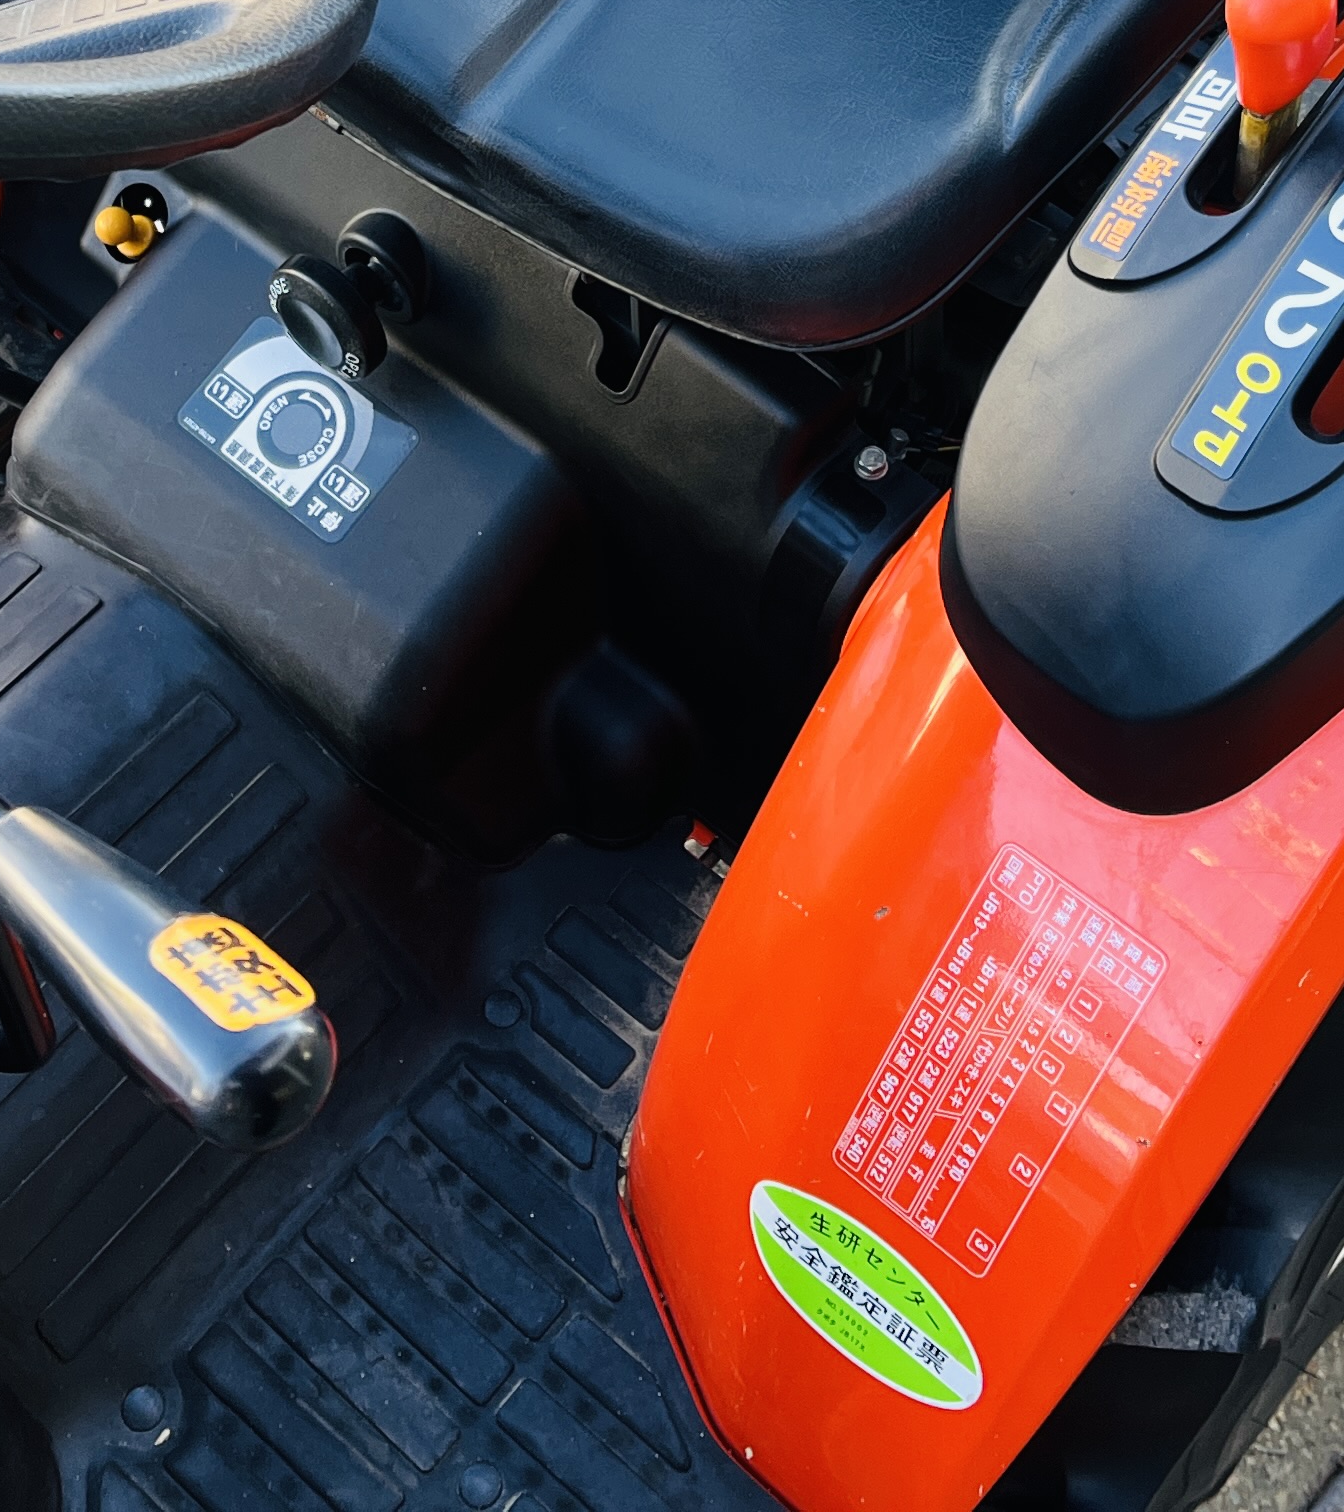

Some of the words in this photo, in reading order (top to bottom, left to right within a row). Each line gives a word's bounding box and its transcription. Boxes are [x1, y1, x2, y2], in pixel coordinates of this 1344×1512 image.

[1161, 69, 1235, 142] 高
[1090, 152, 1179, 249] 副変速
[209, 377, 248, 413] 速い
[1192, 352, 1281, 467] PTO
[259, 395, 289, 432] OPEN
[298, 428, 336, 468] CLOSE
[226, 437, 299, 504] 落下速度調整
[327, 471, 365, 507] 遅い
[307, 496, 343, 532] 停止
[997, 855, 1024, 888] 回転
[1019, 870, 1045, 906] PTO
[1052, 895, 1078, 928] 作業
[1081, 914, 1105, 947] 速度
[1106, 931, 1160, 977] 速度表
[930, 975, 952, 1005] 1速
[973, 956, 998, 993] JB11
[1055, 969, 1073, 989] 0.5
[954, 989, 978, 1024] 1速
[1078, 998, 1092, 1011] 1
[913, 1008, 934, 1039] 551
[1028, 1017, 1044, 1037] 1.5
[1058, 1028, 1074, 1044] 2
[894, 1041, 916, 1071] 2速
[935, 1027, 960, 1060] 523
[1021, 1040, 1036, 1055] 2
[918, 1060, 941, 1090] 2速
[1010, 1057, 1026, 1072] 3
[1041, 1060, 1056, 1075] 3
[878, 1071, 900, 1105] 967
[861, 1100, 886, 1133] 逆転
[904, 1090, 924, 1124] 917
[1053, 1103, 1068, 1116] 1
[845, 1134, 869, 1164] 540
[886, 1122, 911, 1153] 逆転
[869, 1154, 893, 1185] 512
[948, 1166, 965, 1182] 10
[1016, 1162, 1032, 1178] 2
[920, 1216, 937, 1233] 15
[974, 1238, 989, 1253] 3
[809, 1210, 943, 1331] 生研センター
[772, 1217, 950, 1374] 安全鑑定証票
